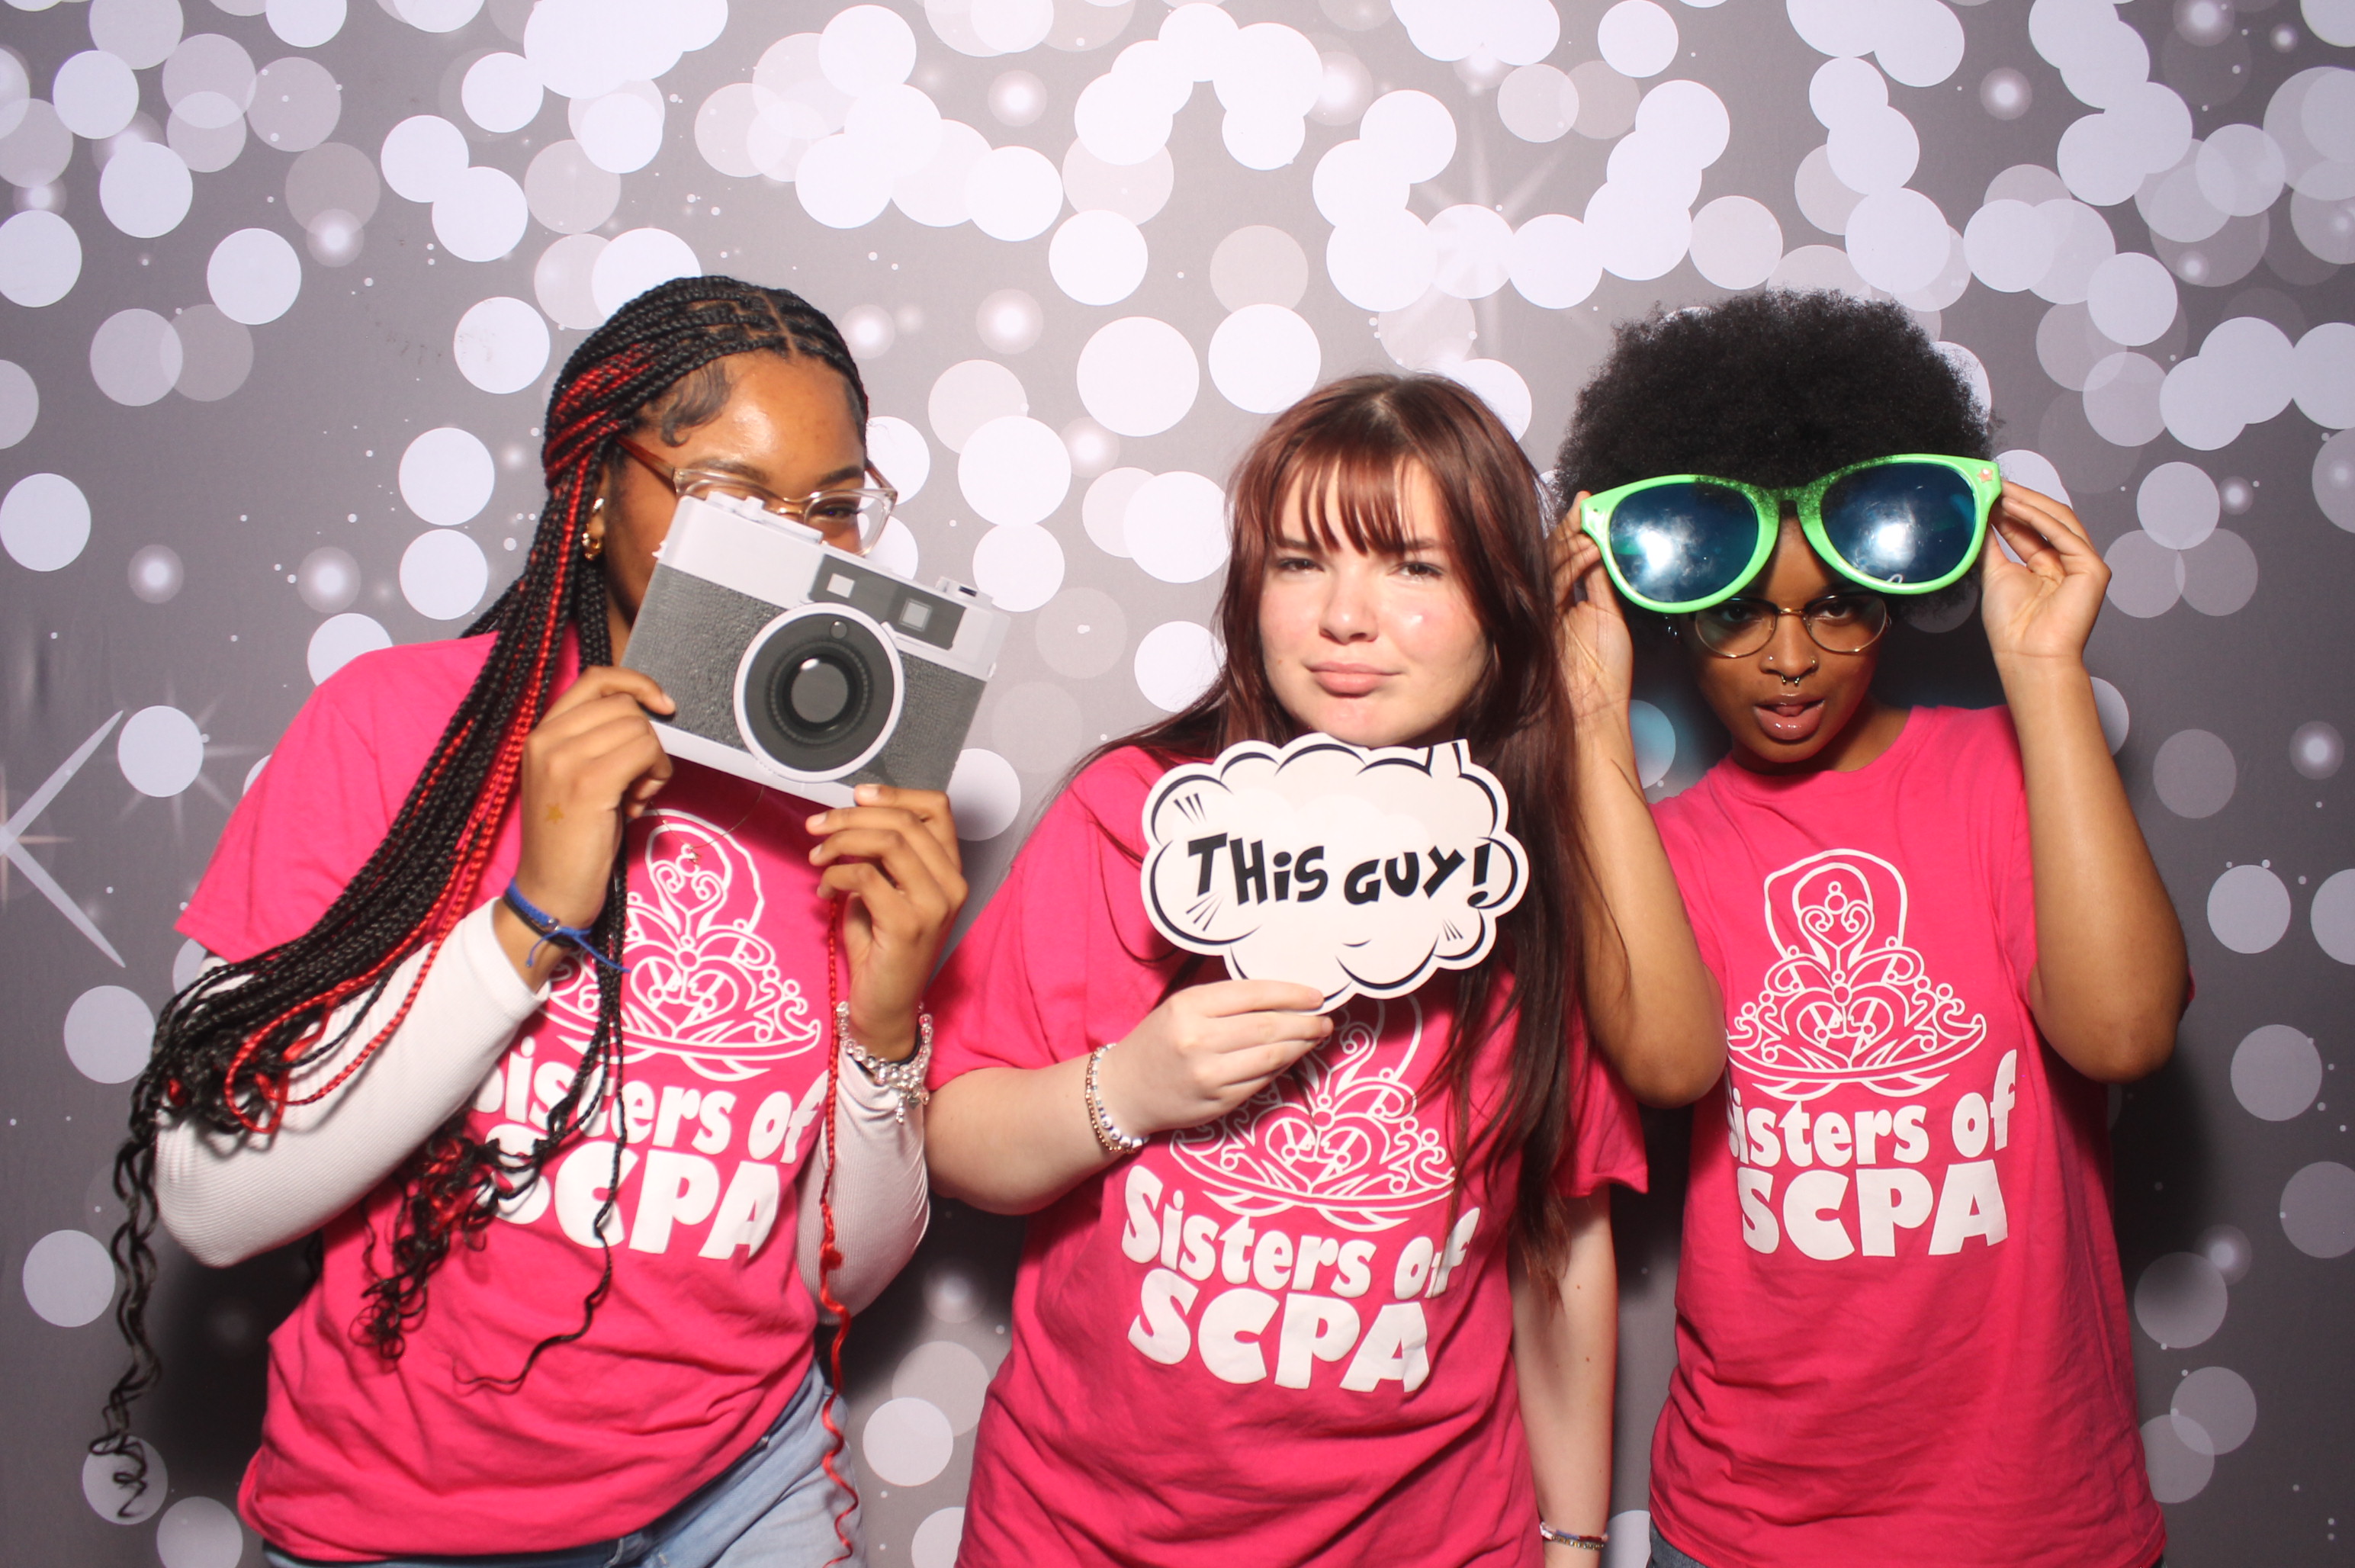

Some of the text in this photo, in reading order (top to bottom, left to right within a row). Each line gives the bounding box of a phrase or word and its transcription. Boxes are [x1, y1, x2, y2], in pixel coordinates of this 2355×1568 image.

[1343, 842, 1492, 908] GUY!
[747, 1068, 830, 1165] of
[1951, 1049, 2017, 1158] of
[474, 1123, 780, 1260] SCPA
[1120, 1165, 1481, 1300] Sisters of
[1737, 1158, 2008, 1261] SCPA
[1127, 1267, 1430, 1393] SCPA
